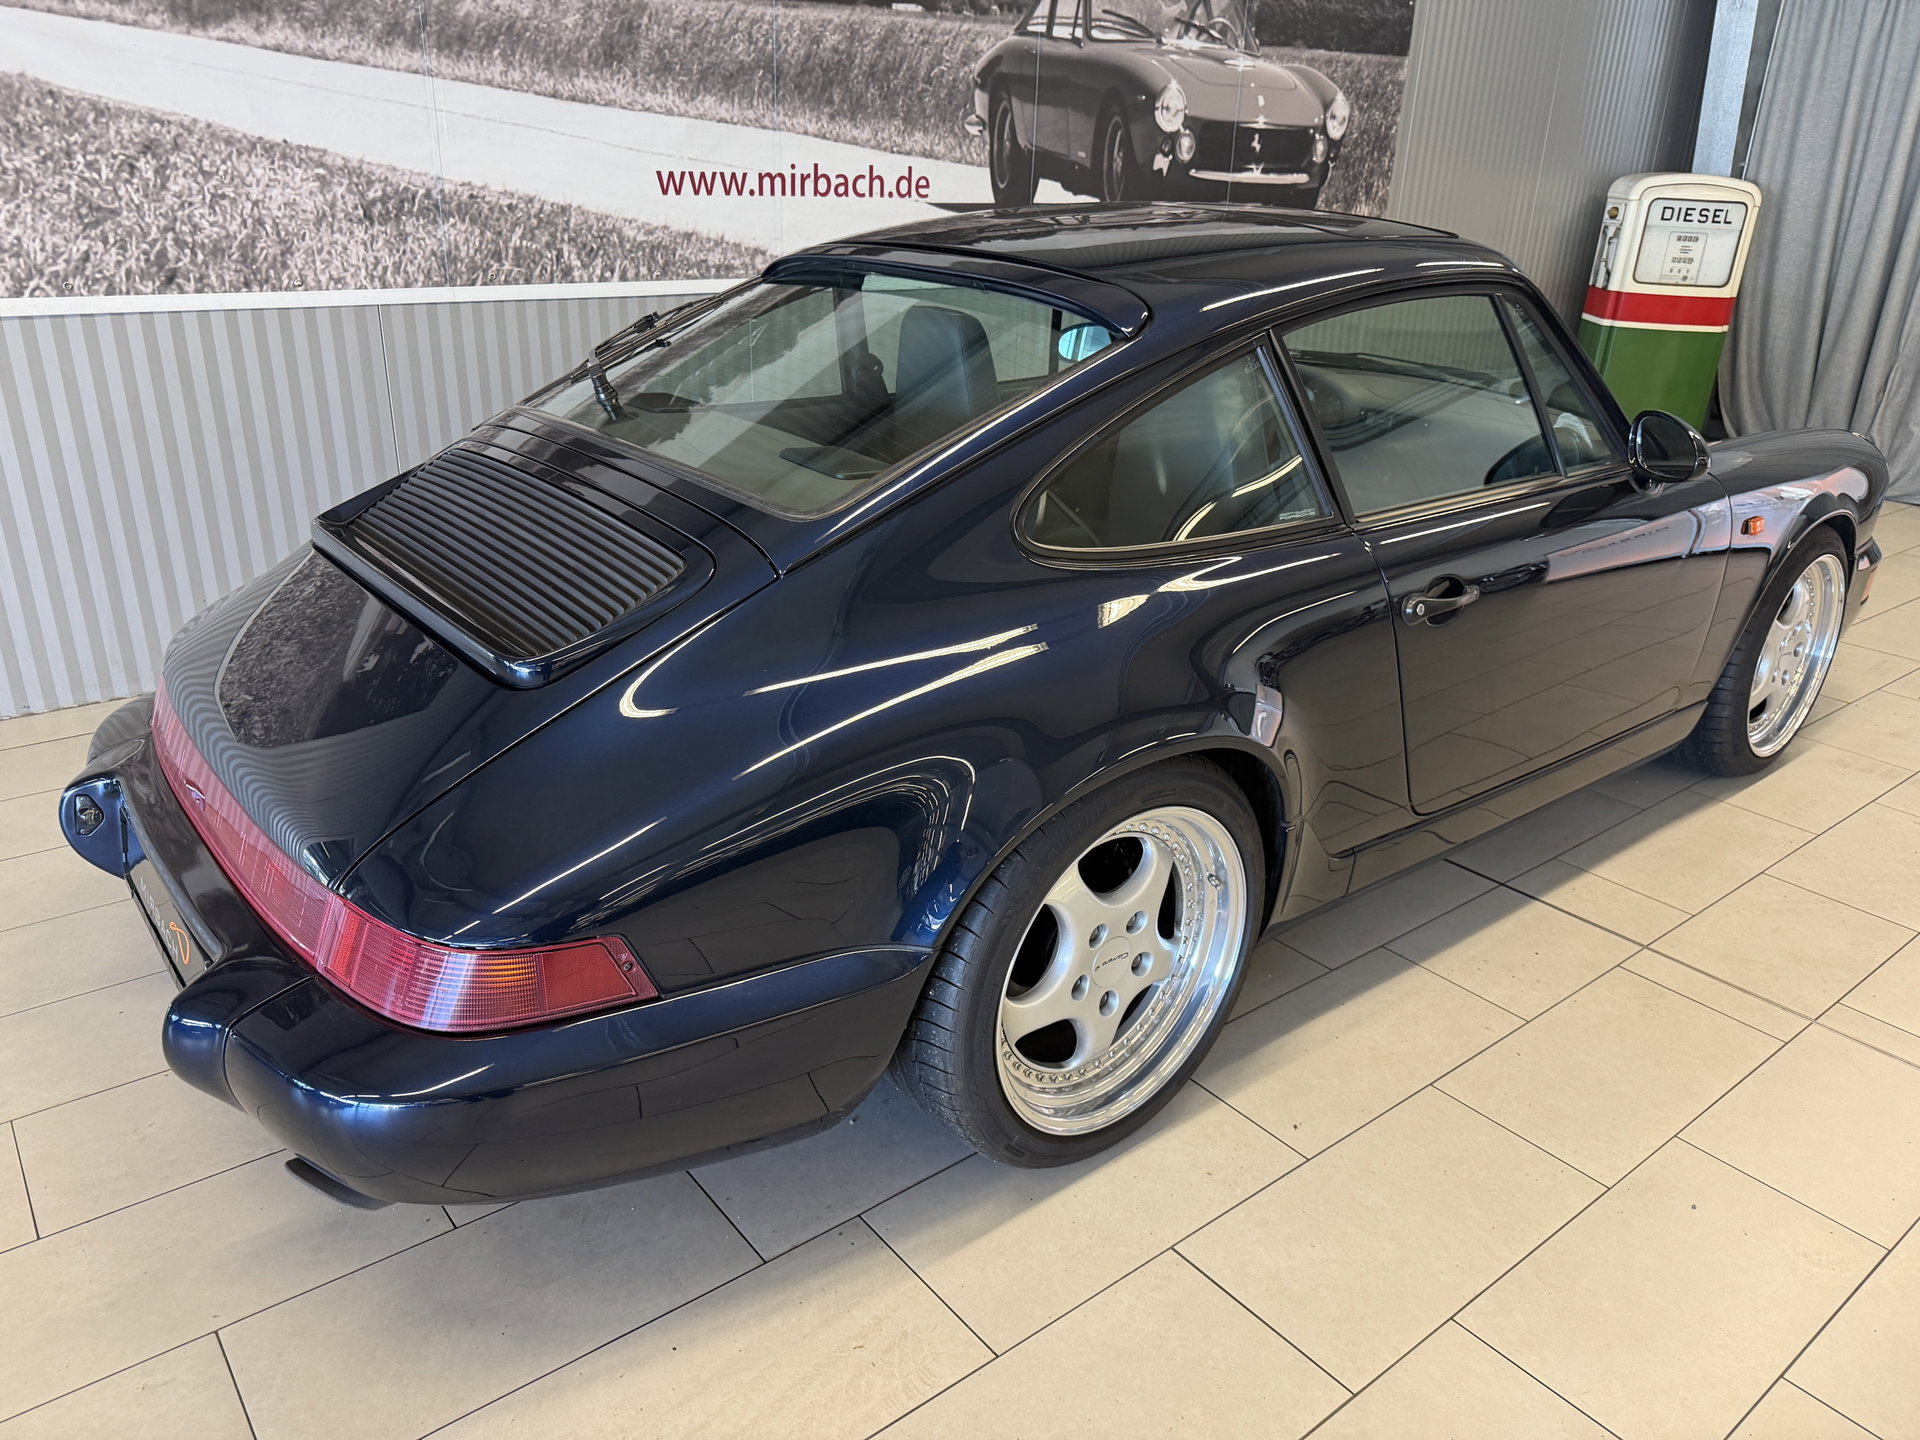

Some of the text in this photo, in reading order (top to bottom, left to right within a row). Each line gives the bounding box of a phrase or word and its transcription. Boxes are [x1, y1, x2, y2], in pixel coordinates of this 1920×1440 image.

[656, 163, 930, 198] www.mirbach.de
[1660, 206, 1732, 224] DIESEL
[140, 877, 179, 963] MIRBACH
